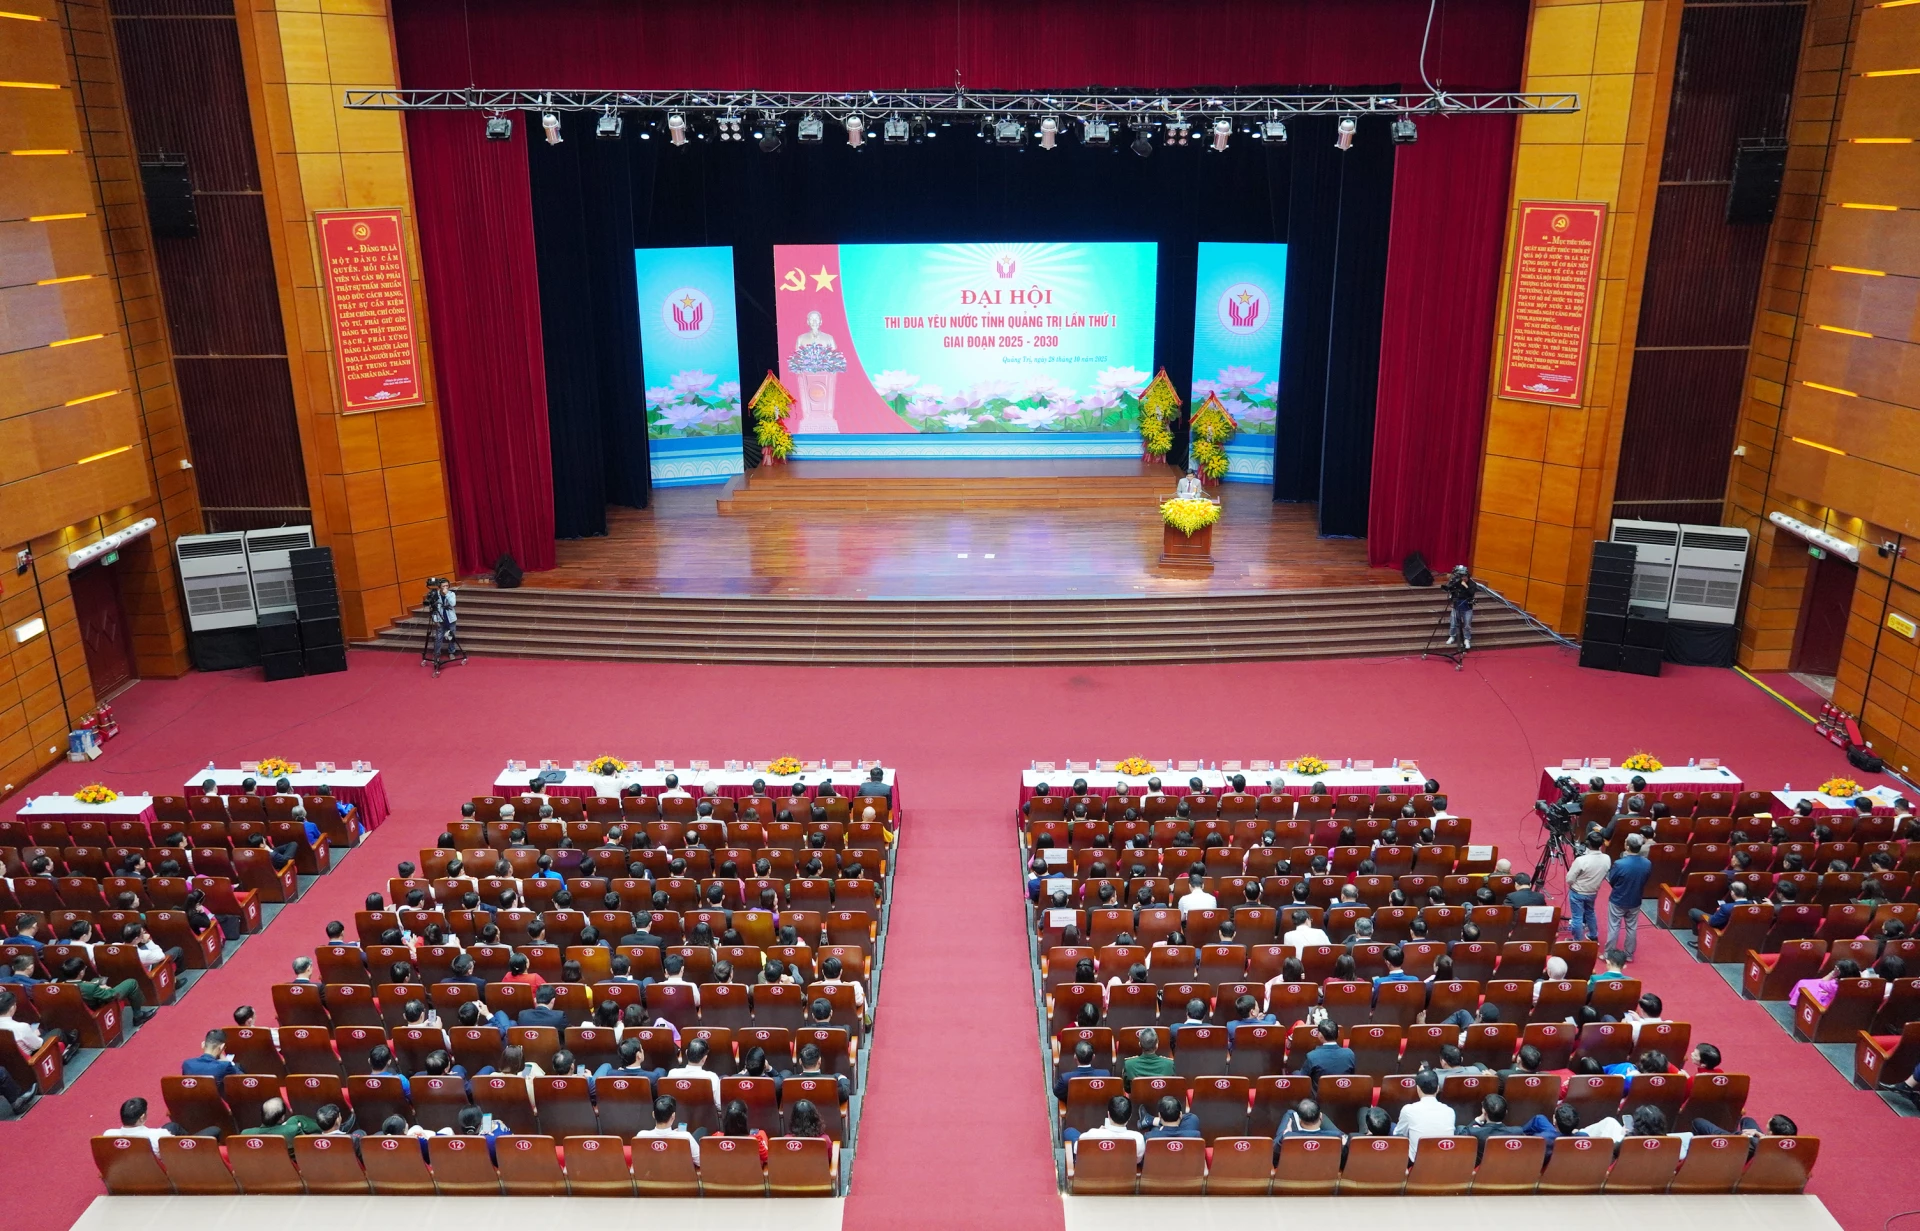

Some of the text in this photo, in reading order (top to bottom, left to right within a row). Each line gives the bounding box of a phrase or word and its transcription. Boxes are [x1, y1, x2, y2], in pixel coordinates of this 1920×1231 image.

[961, 285, 1052, 308] ĐẠI HỘI
[885, 316, 900, 328] THI
[904, 316, 924, 328] ĐUA
[928, 314, 946, 328] YÊU
[950, 312, 978, 328] NƯỚC
[982, 312, 1004, 328] TỈNH
[1008, 311, 1043, 328] QUẢNG
[1046, 316, 1062, 330] TRỊ
[1089, 312, 1109, 327] THỨ
[1112, 316, 1116, 327] I
[944, 336, 963, 347] GIAI
[967, 336, 995, 350] ĐOẠN
[999, 336, 1023, 347] 2025
[1034, 336, 1058, 347] 2030
[1002, 356, 1021, 364] Quảng
[319, 847, 325, 857] B
[1663, 900, 1670, 912] D
[249, 905, 256, 917] D
[208, 937, 216, 952] E
[1704, 933, 1712, 948] E
[1751, 965, 1758, 976] F
[160, 972, 167, 987] F
[106, 1012, 114, 1025] G
[1804, 1008, 1811, 1022] G
[1865, 1052, 1874, 1068] H
[43, 1057, 53, 1076] H
[1217, 1080, 1228, 1088] 05
[1338, 1079, 1349, 1087] 09
[1403, 1078, 1414, 1087] 11
[1527, 1078, 1538, 1086] 15
[1652, 1077, 1663, 1085] 19
[116, 1140, 128, 1148] 22
[181, 1140, 194, 1148] 20
[248, 1139, 261, 1148] 18
[316, 1140, 329, 1148] 16
[384, 1140, 396, 1149] 14
[451, 1141, 463, 1149] 12
[518, 1141, 530, 1149] 10
[585, 1141, 597, 1150] 08
[653, 1142, 666, 1150] 06
[721, 1142, 733, 1150] 04
[788, 1141, 800, 1150] 02
[1101, 1141, 1113, 1149] 01
[1169, 1142, 1181, 1150] 03
[1236, 1142, 1248, 1150] 05
[1306, 1141, 1318, 1150] 07
[1374, 1141, 1386, 1150] 09
[1440, 1140, 1453, 1149] 11
[1507, 1140, 1520, 1149] 13
[1577, 1140, 1589, 1149] 15
[1645, 1140, 1657, 1148] 17
[1714, 1139, 1726, 1148] 19
[1781, 1140, 1794, 1148] 21
